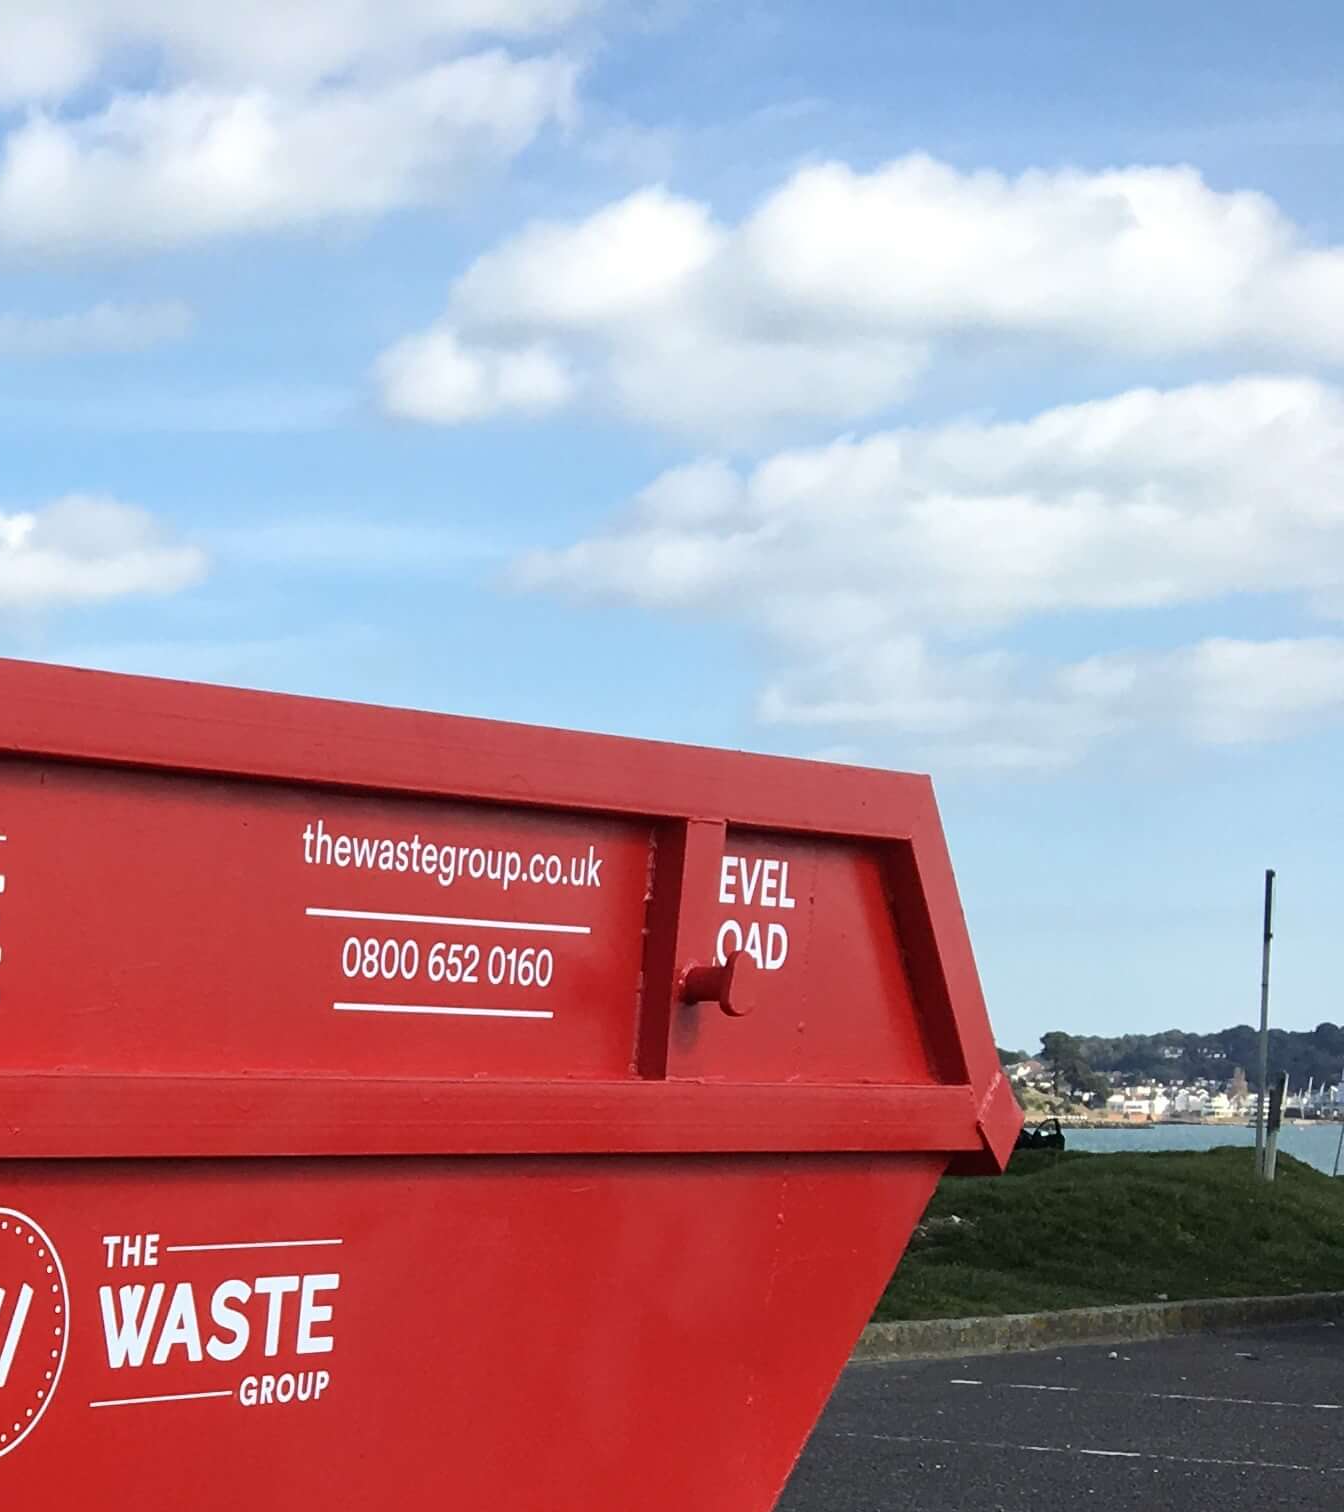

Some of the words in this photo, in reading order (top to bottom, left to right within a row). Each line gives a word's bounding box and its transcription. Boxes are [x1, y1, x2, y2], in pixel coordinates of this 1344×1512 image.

[302, 819, 603, 892] thewastegroup.co.uk
[718, 855, 796, 909] EVEL
[342, 936, 420, 980] 0800
[427, 942, 480, 983] 652
[487, 945, 553, 988] 0160
[713, 919, 788, 970] OAD
[103, 1233, 160, 1268] THE
[99, 1273, 340, 1369] WASTE
[239, 1370, 330, 1407] GROUP
